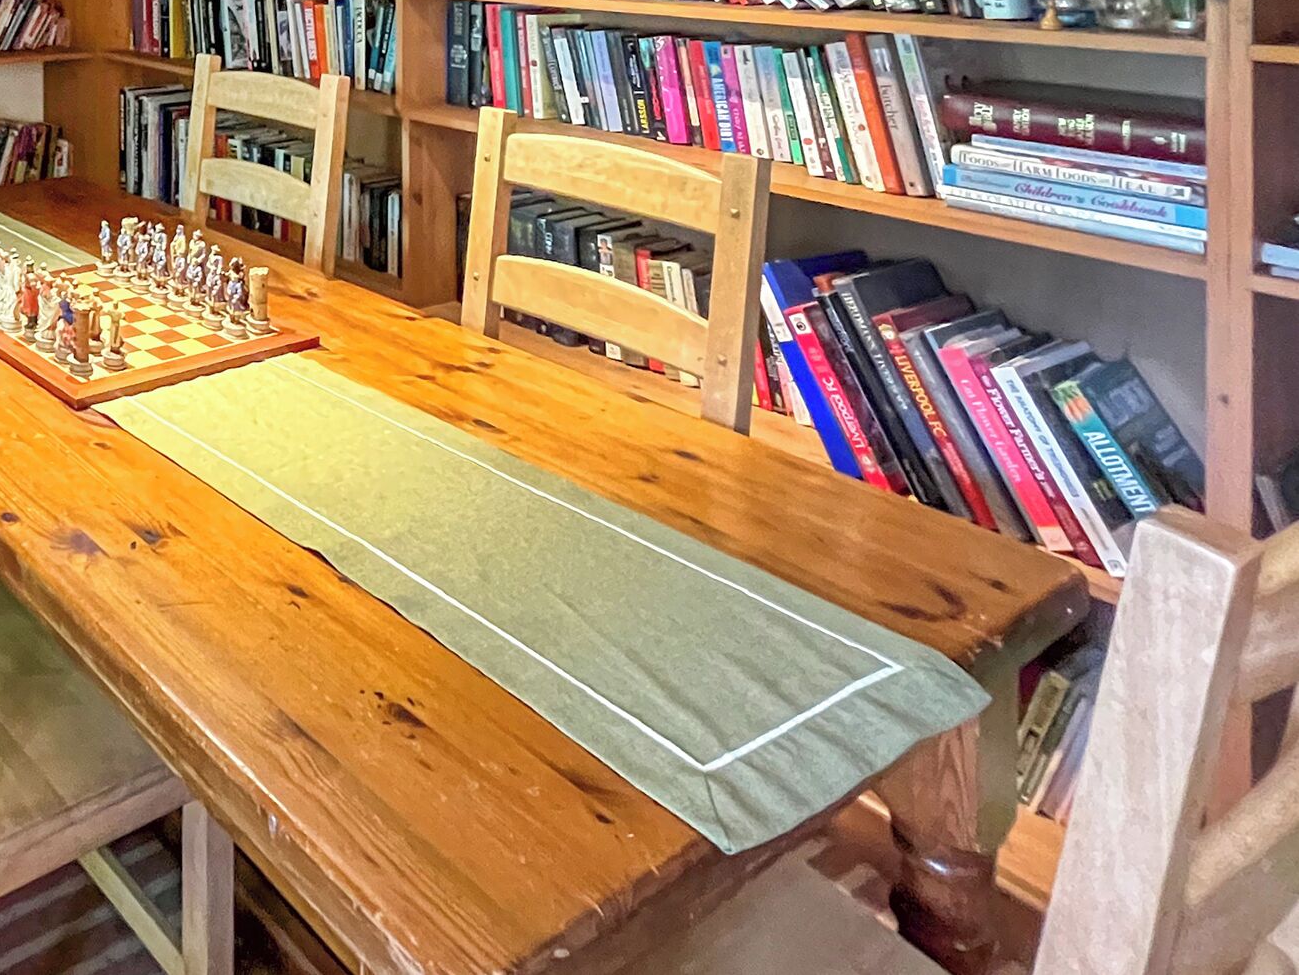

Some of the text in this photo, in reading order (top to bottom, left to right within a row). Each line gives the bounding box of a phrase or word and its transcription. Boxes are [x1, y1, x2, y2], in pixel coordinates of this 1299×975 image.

[712, 77, 734, 143] AMERICAN DIRT
[880, 82, 900, 130] butcher
[822, 376, 866, 450] Liverpool FC
[895, 354, 948, 438] LIVERPOOL FC
[988, 387, 1012, 427] Flower
[1009, 426, 1045, 481] Farmer's
[969, 397, 998, 440] Flower
[993, 438, 1022, 484] Garden
[1083, 430, 1157, 514] ALLOTMENT
